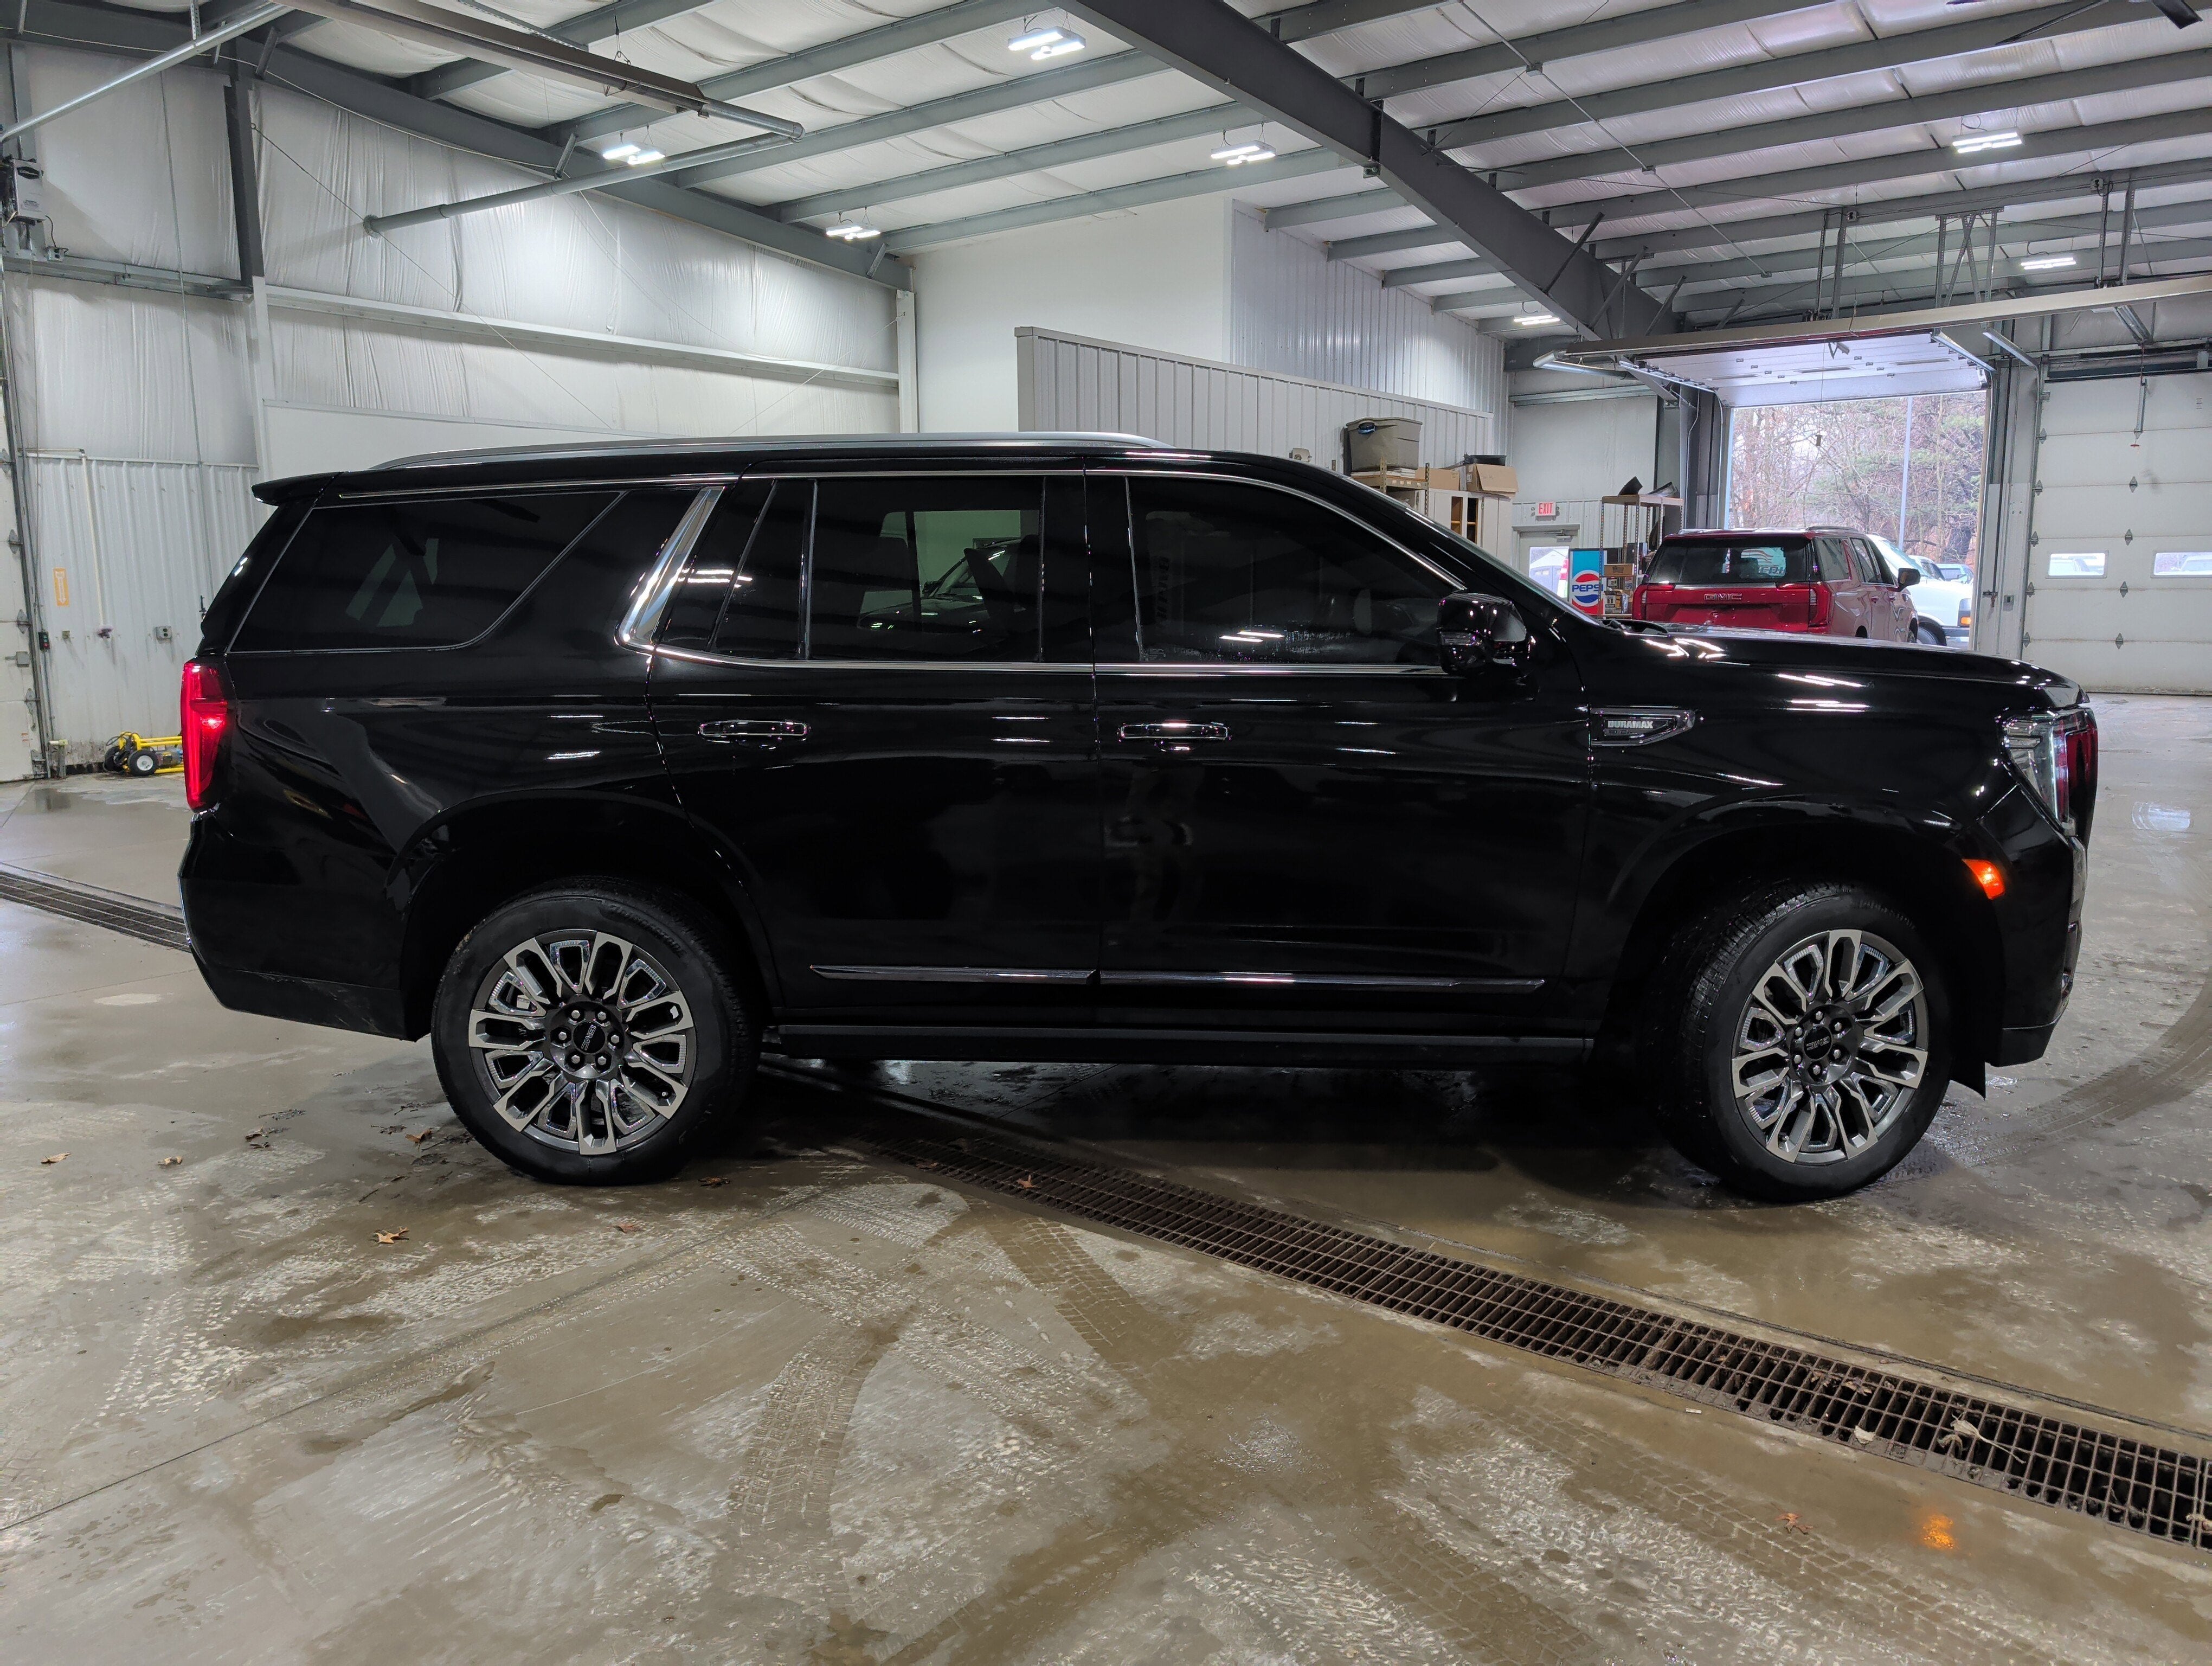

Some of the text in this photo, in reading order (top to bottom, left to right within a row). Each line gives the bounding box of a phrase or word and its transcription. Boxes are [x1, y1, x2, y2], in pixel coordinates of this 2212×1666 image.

[1539, 503, 1553, 514] EXIT
[1704, 593, 1742, 601] GMC
[1607, 720, 1654, 728] DURAMAX
[581, 1024, 597, 1051] GMC
[1806, 1036, 1830, 1050] GMC
